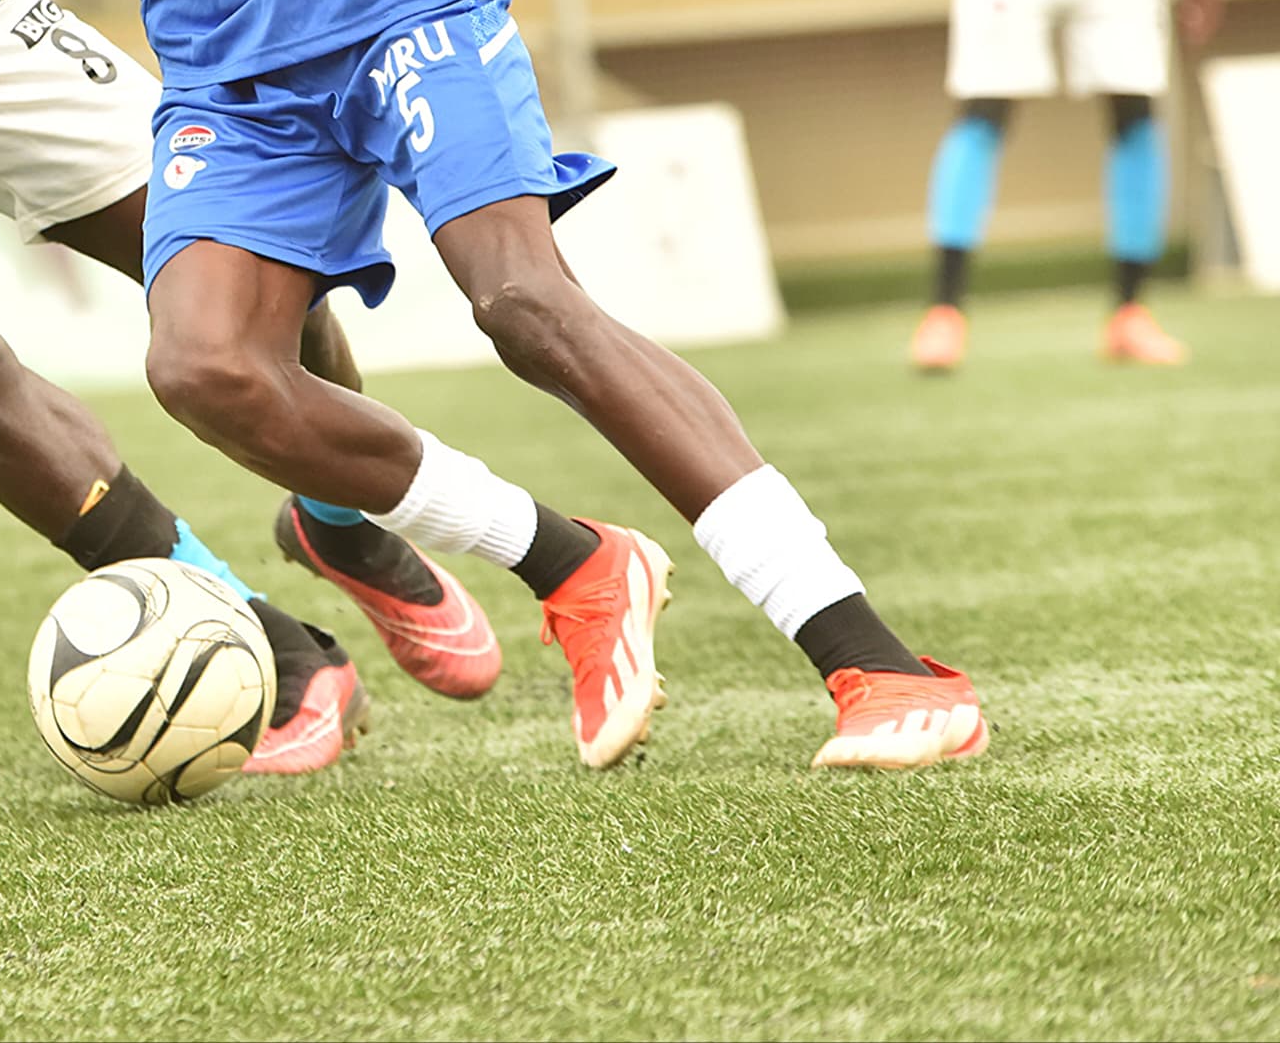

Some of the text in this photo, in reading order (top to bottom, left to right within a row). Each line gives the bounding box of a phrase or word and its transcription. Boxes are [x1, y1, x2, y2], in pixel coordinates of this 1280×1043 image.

[51, 28, 117, 84] 8
[368, 20, 456, 106] MRU
[396, 70, 435, 153] 5
